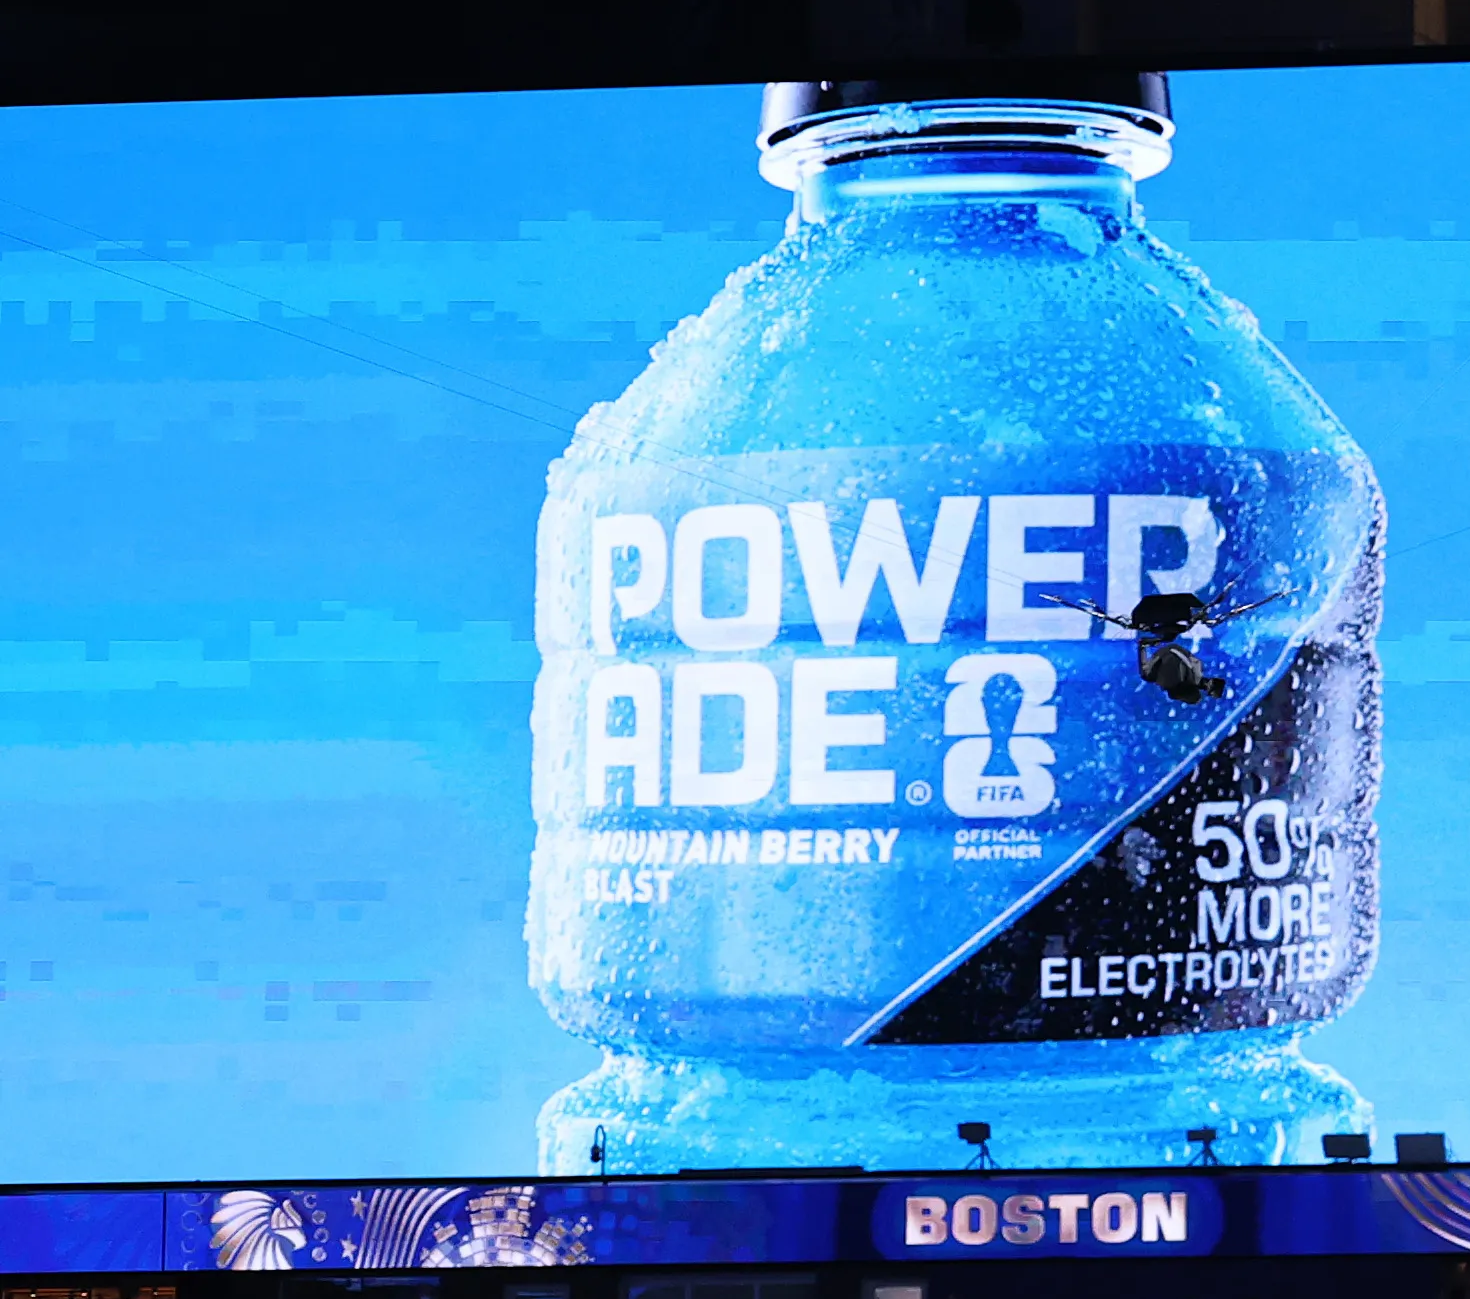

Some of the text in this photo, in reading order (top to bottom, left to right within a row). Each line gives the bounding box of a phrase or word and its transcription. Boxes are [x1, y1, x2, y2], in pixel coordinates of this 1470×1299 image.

[594, 492, 1224, 652] POWER
[584, 654, 898, 808] ADE
[976, 784, 1026, 803] FIFA
[588, 827, 900, 865] MOUNTAIN BERRY
[953, 845, 1043, 861] PARTNER
[954, 827, 1041, 845] OFFICIAL
[1191, 798, 1336, 882] 50%
[584, 867, 674, 906] BLAST
[1198, 882, 1332, 949] MORE
[1040, 947, 1334, 1000] ELECTROLYTES
[905, 1192, 1187, 1246] BOSTON
